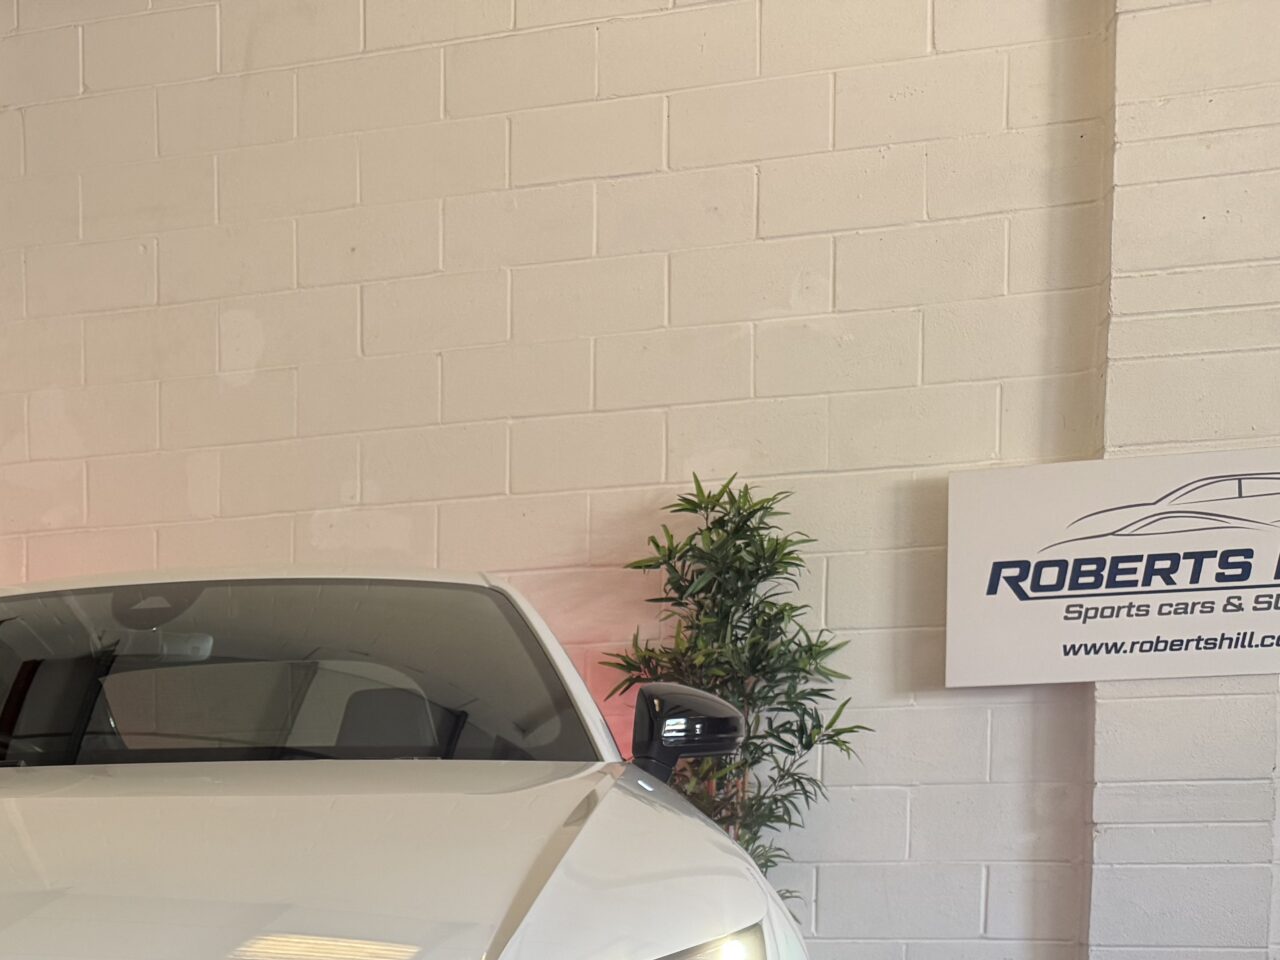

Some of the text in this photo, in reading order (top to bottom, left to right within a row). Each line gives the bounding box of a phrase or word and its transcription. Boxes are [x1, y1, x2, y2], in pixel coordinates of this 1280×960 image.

[986, 548, 1254, 601] ROBERTS
[1063, 601, 1150, 624] Sports
[1157, 599, 1215, 617] cars
[1222, 595, 1244, 613] &
